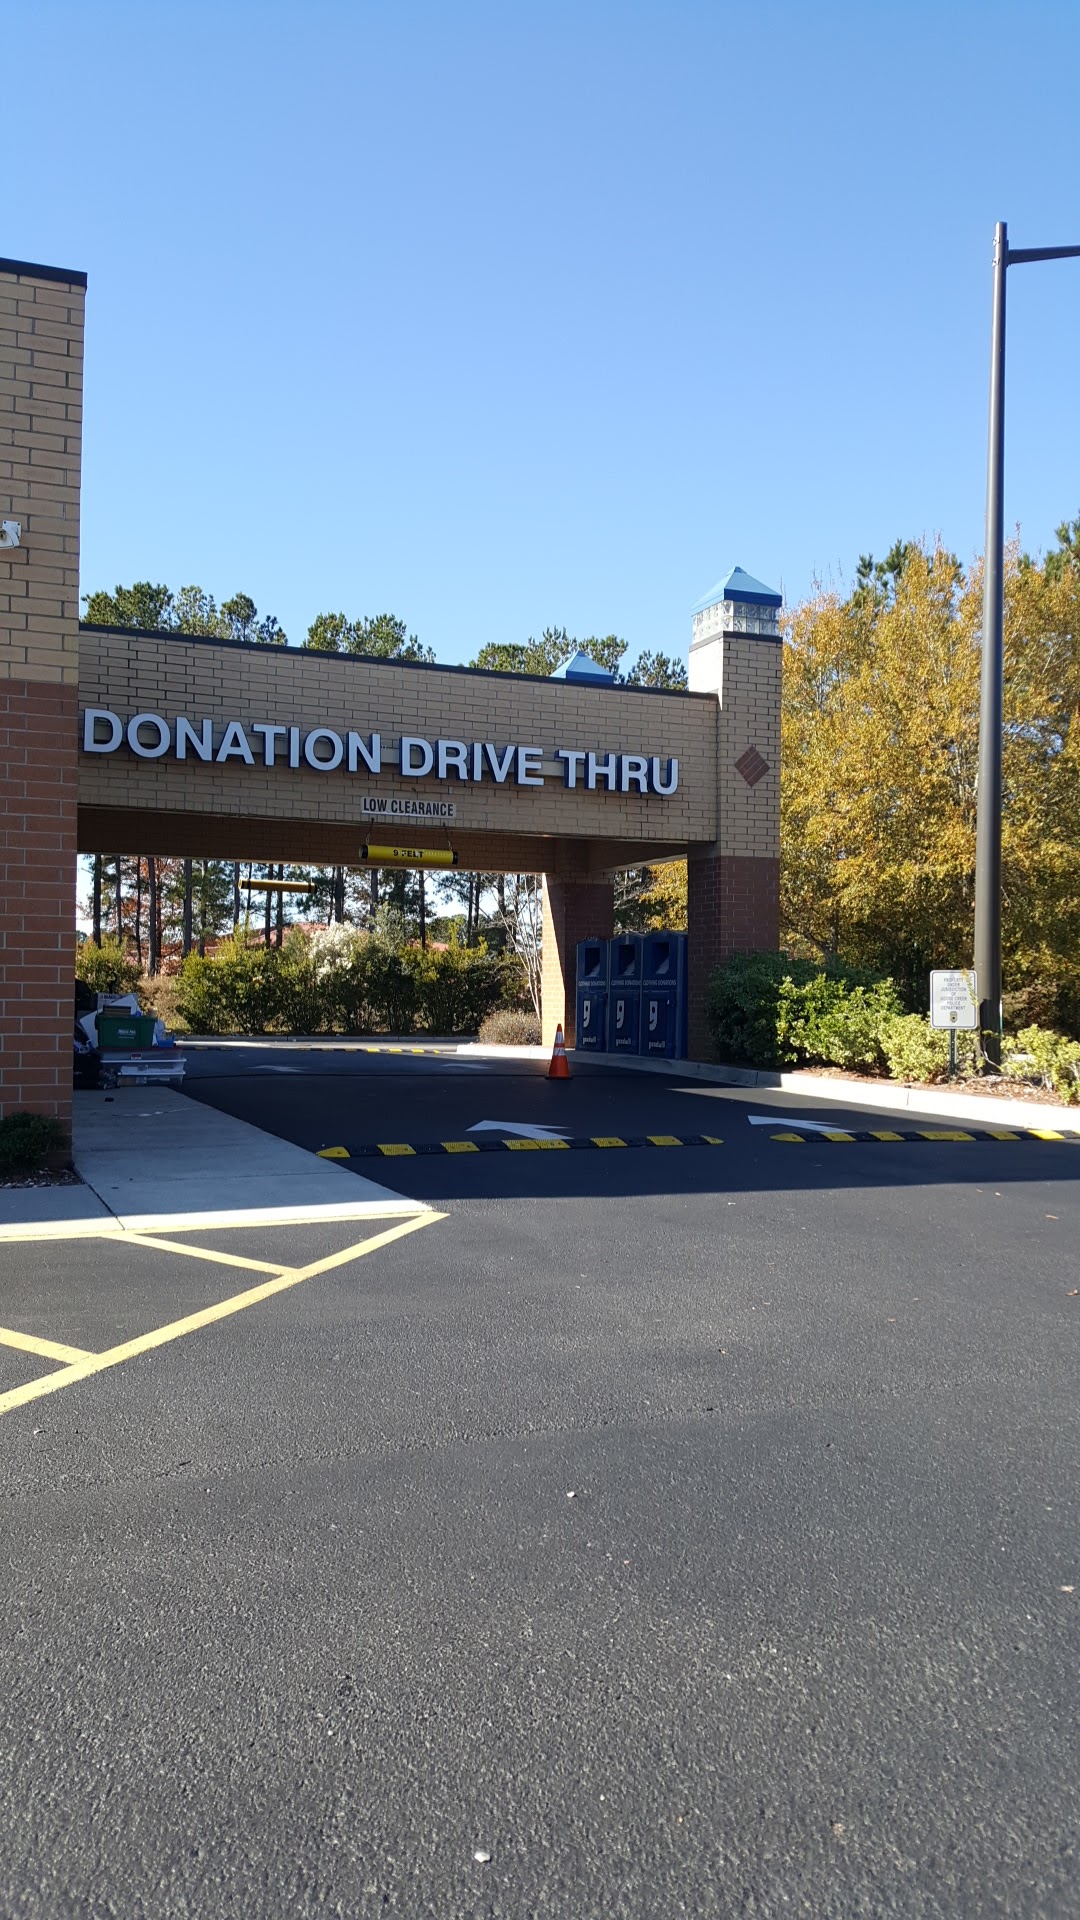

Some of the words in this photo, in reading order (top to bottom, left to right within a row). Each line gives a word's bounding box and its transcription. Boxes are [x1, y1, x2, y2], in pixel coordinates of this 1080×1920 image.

[83, 708, 381, 774] DONATION
[400, 736, 545, 787] DRIVE
[555, 749, 679, 795] THRU
[363, 798, 387, 812] LOW
[391, 800, 454, 816] CLEARANCE
[393, 849, 399, 857] 9
